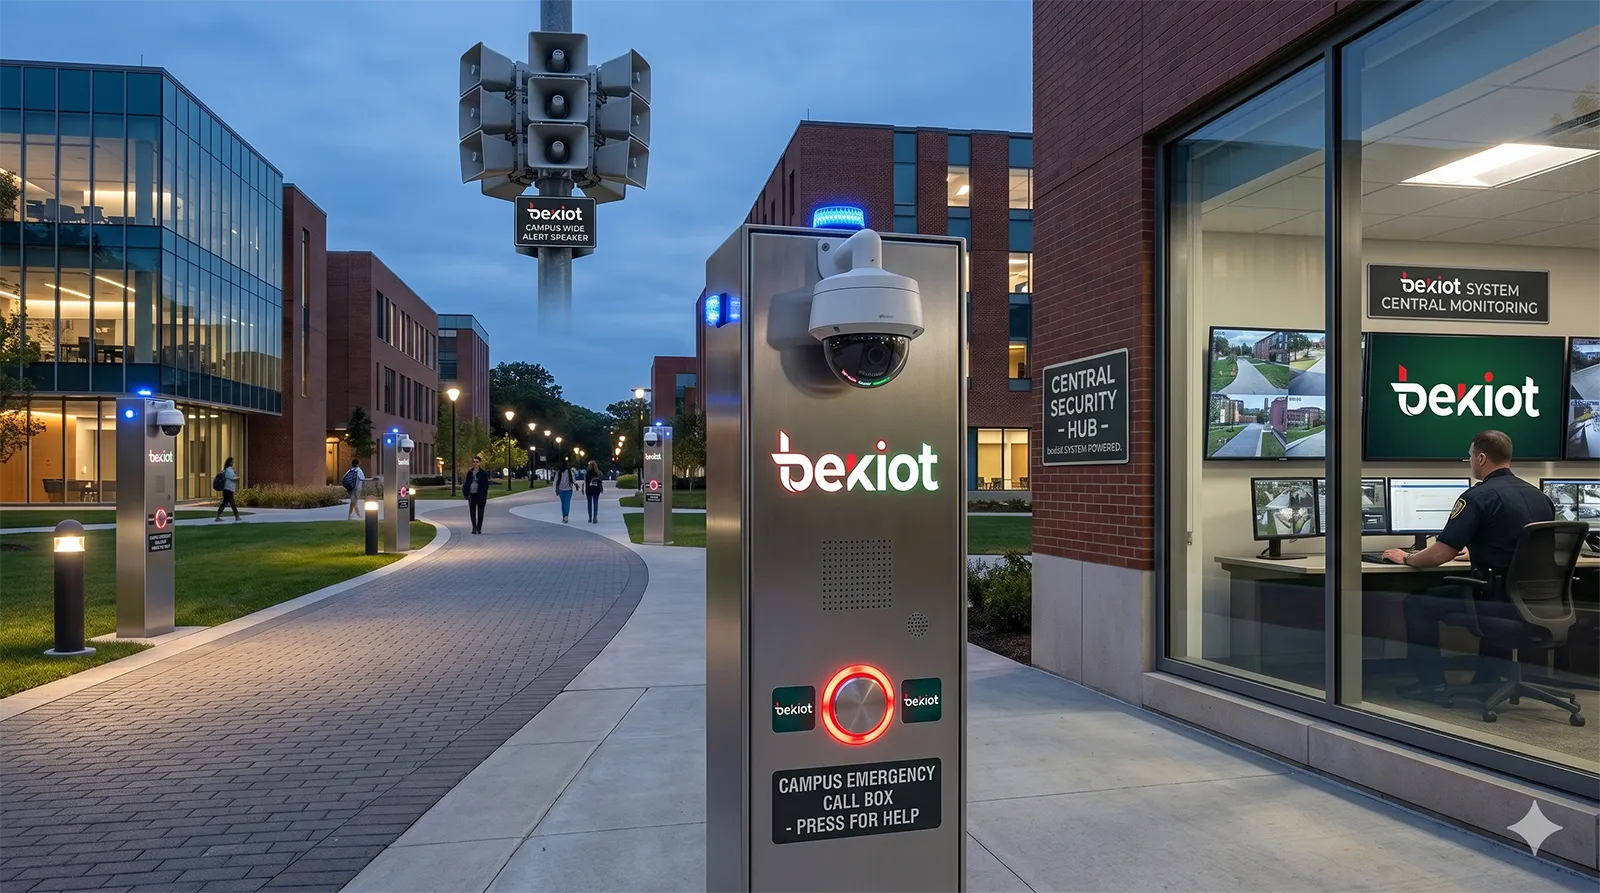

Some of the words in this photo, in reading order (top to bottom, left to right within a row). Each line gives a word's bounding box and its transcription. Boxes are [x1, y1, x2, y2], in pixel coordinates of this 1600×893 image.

[522, 233, 549, 241] ALERT
[525, 224, 561, 232] CAMPUS
[1466, 282, 1520, 297] SYSTEM
[1381, 296, 1446, 311] CENTRAL
[1450, 299, 1538, 315] MONITORING
[1051, 364, 1116, 394] CENTRAL
[1390, 364, 1541, 418] bekiot
[1050, 389, 1118, 417] SECURITY
[1067, 418, 1098, 439] HUB
[1064, 444, 1087, 454] SYSTEM
[1087, 442, 1123, 453] POWERED.
[770, 429, 940, 493] bekiot
[778, 773, 842, 794] CAMPUS
[846, 765, 936, 788] EMERGENCY
[823, 792, 860, 811] CALL
[864, 789, 894, 807] BOX
[796, 815, 845, 835] PRESS
[849, 812, 878, 829] FOR
[883, 807, 920, 826] HELP
